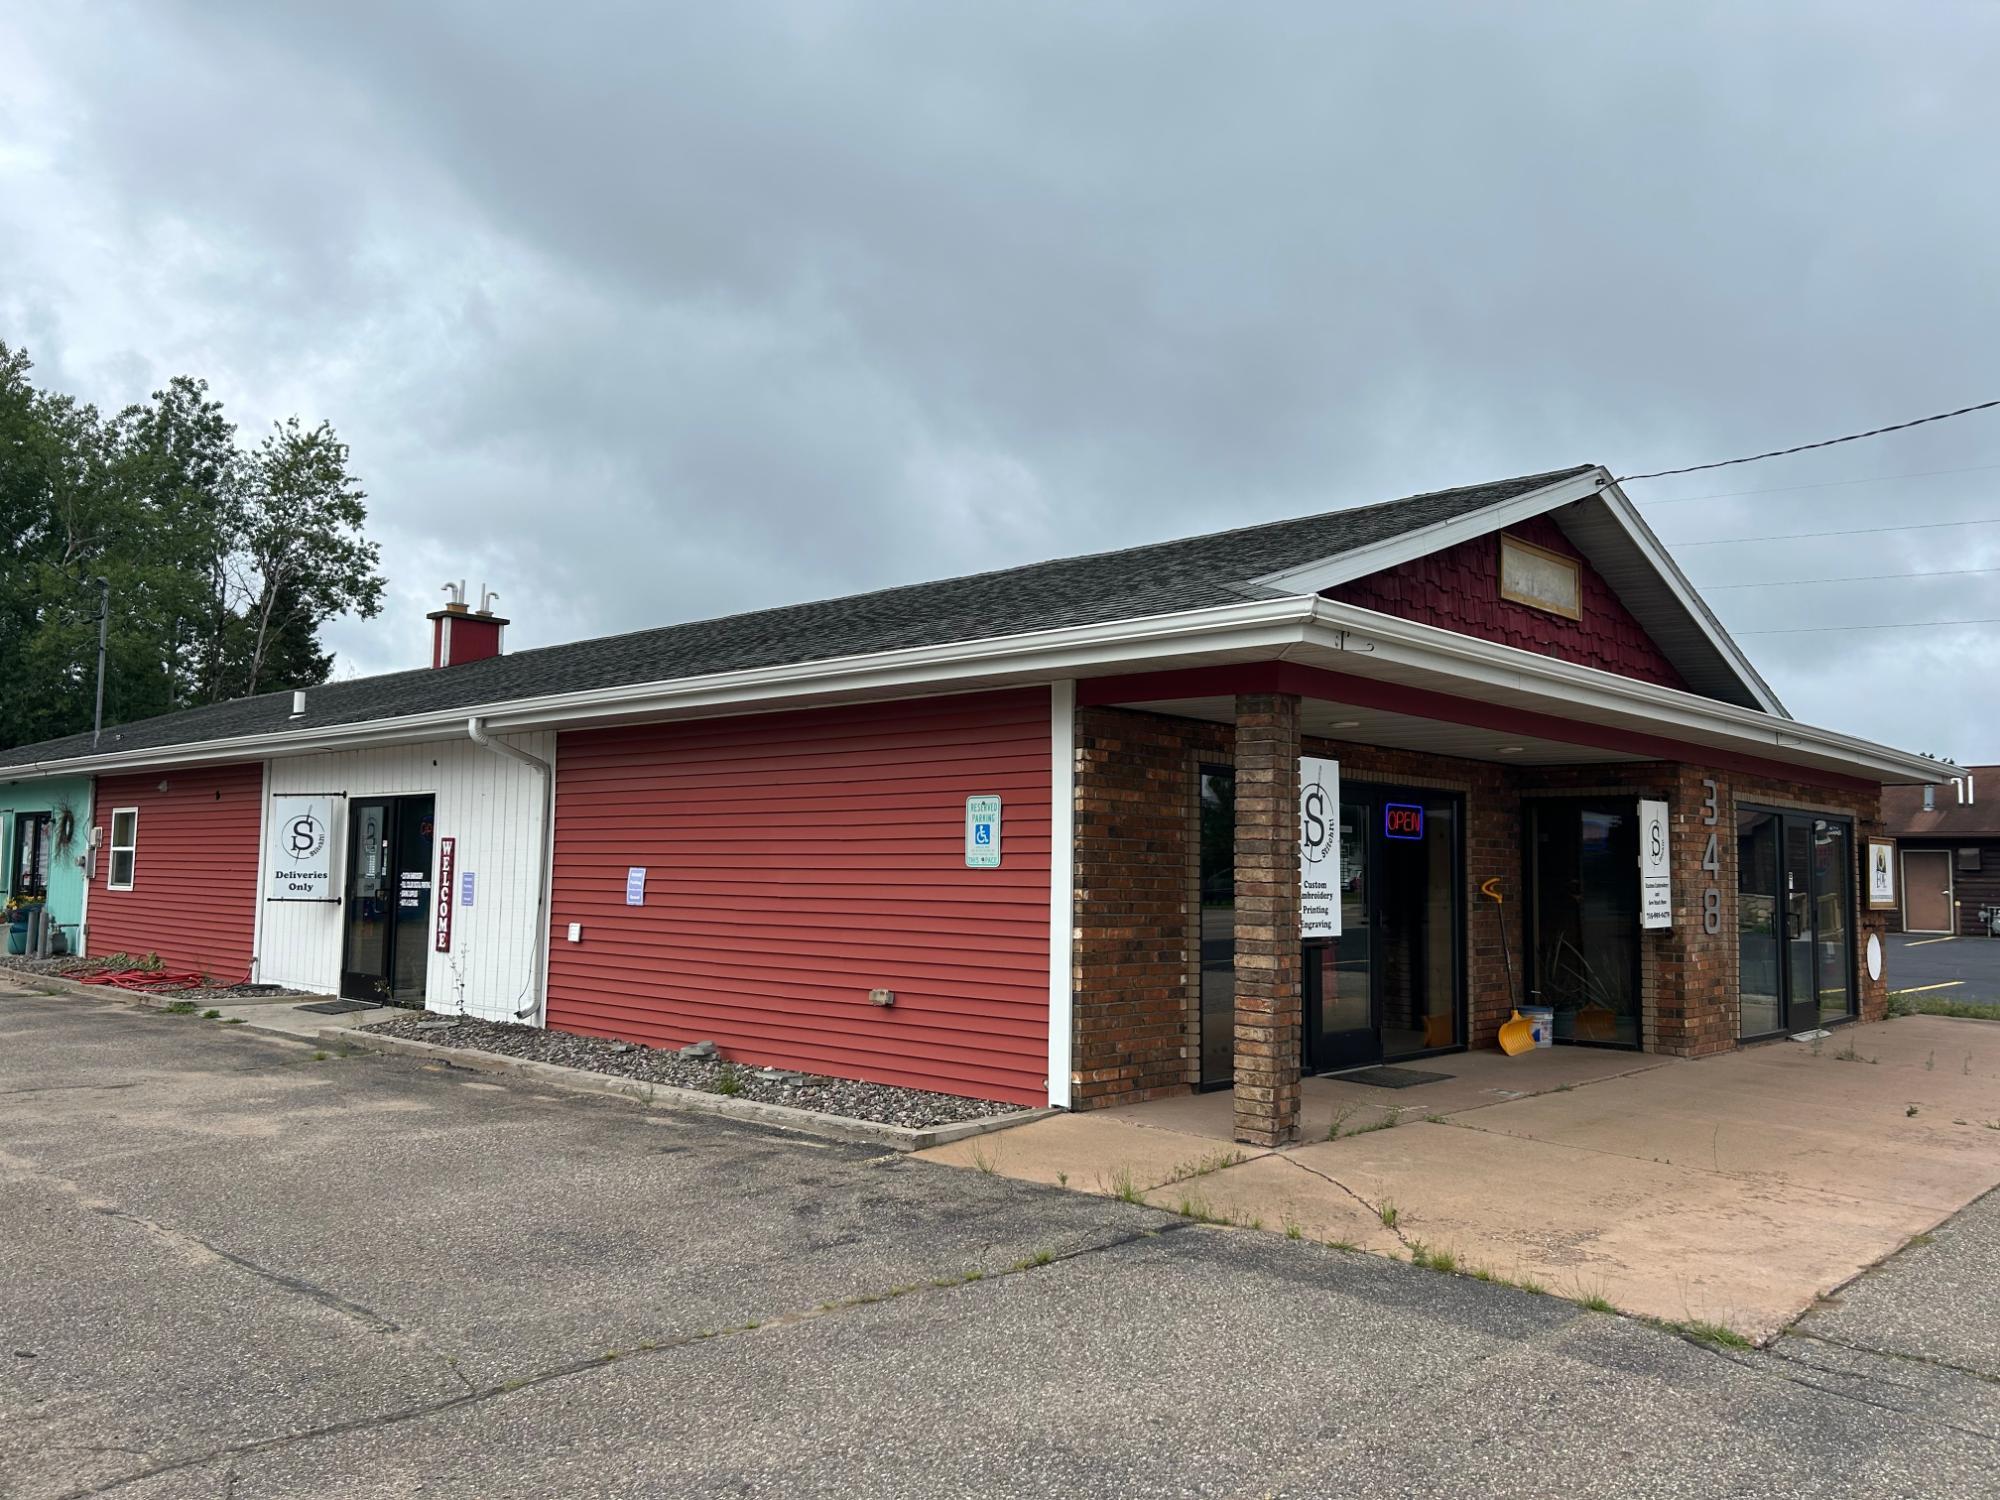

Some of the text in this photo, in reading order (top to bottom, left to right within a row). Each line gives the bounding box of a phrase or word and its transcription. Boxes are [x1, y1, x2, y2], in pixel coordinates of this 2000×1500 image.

[970, 802, 997, 812] RESERVED
[972, 813, 995, 822] PARKING
[1388, 810, 1420, 832] OPEN
[1703, 779, 1720, 934] 348
[275, 871, 328, 879] Deliveries
[288, 883, 313, 892] Only
[1304, 881, 1327, 889] Custom
[438, 841, 453, 948] WELCOME
[1301, 891, 1333, 901] mbroidery
[1303, 905, 1329, 915] Printing
